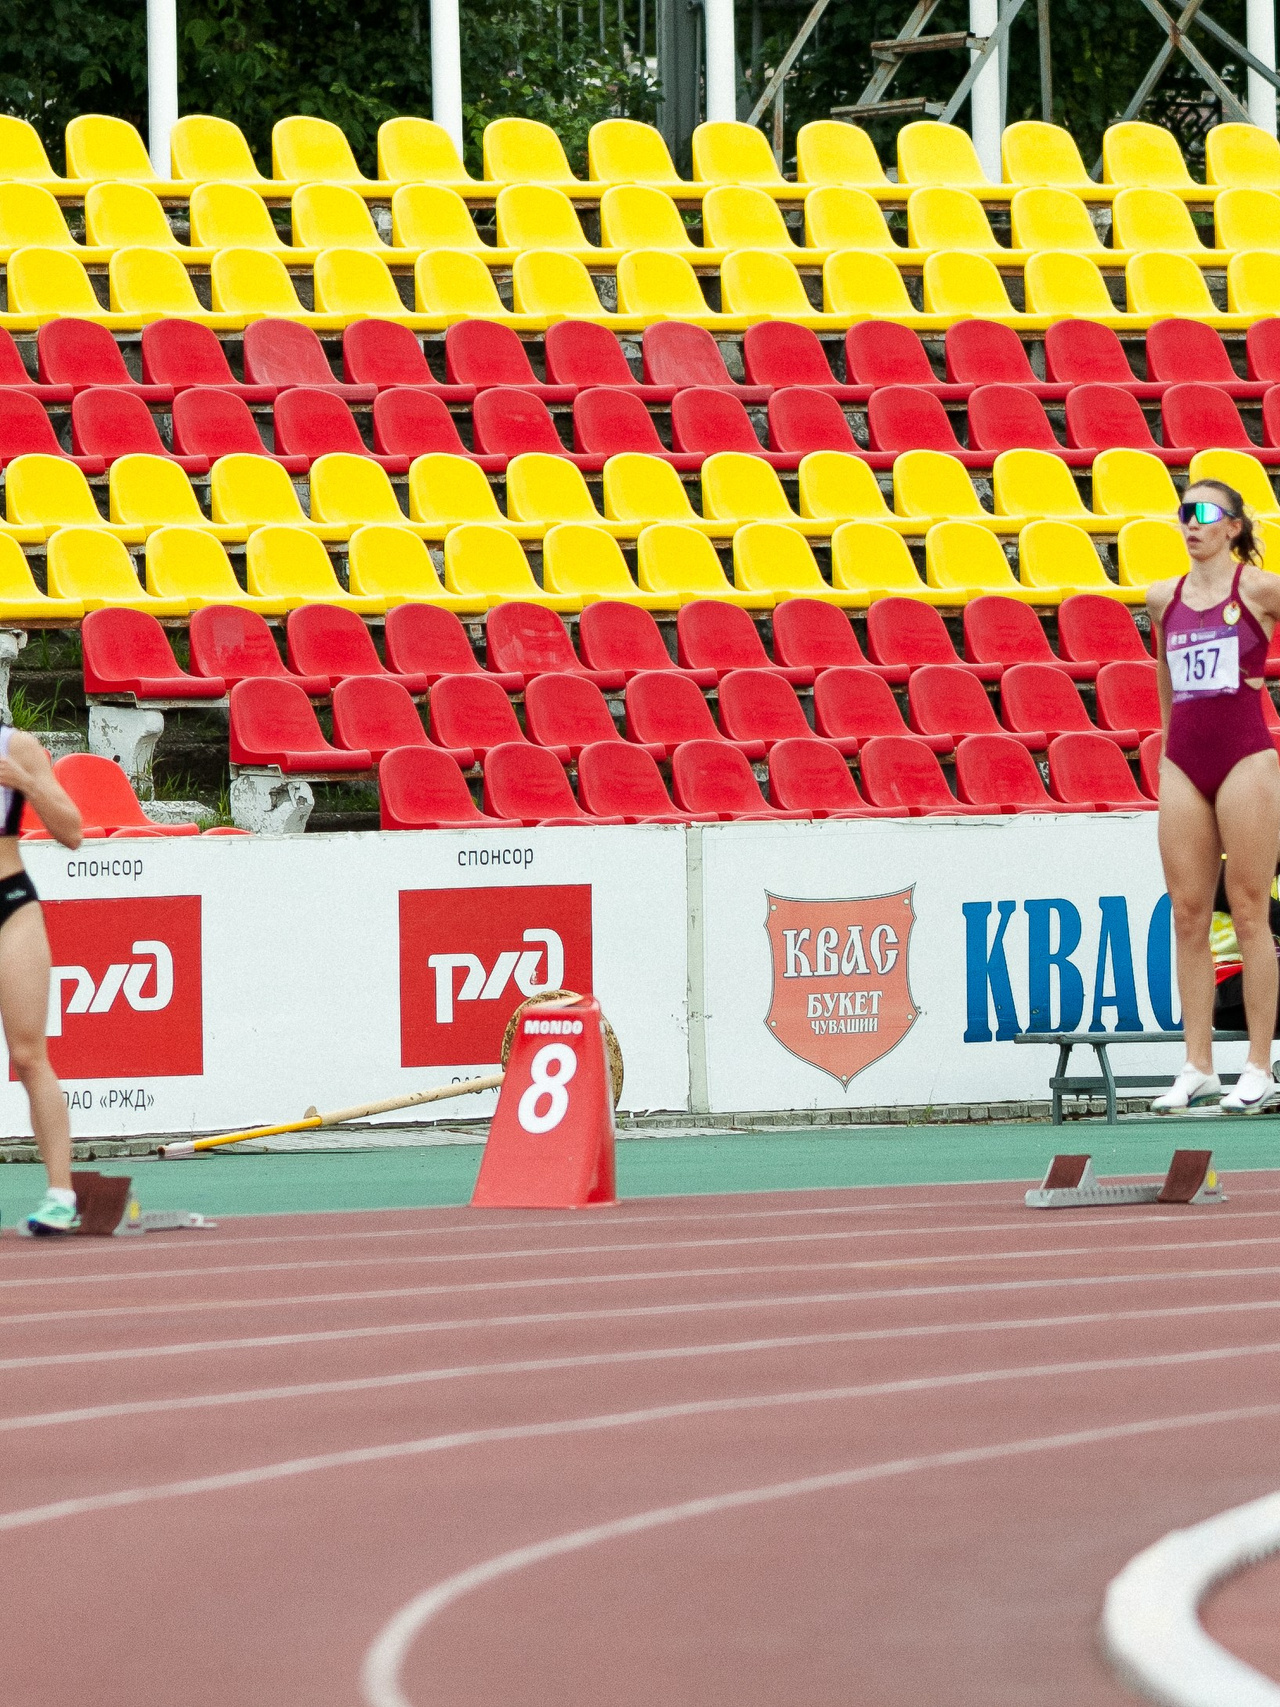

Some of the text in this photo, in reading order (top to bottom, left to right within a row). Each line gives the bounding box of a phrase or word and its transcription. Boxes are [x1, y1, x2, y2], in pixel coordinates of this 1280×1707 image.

[1183, 648, 1220, 682] 157
[457, 848, 534, 869] спонсор
[67, 859, 143, 881] спонсор
[782, 924, 899, 978] КВАС
[806, 990, 883, 1018] БУКЕТ
[523, 1020, 585, 1035] MONDO
[811, 1017, 879, 1035] ЧУВАШИИ
[517, 1042, 578, 1134] 8
[99, 1089, 155, 1111] «РЖД»
